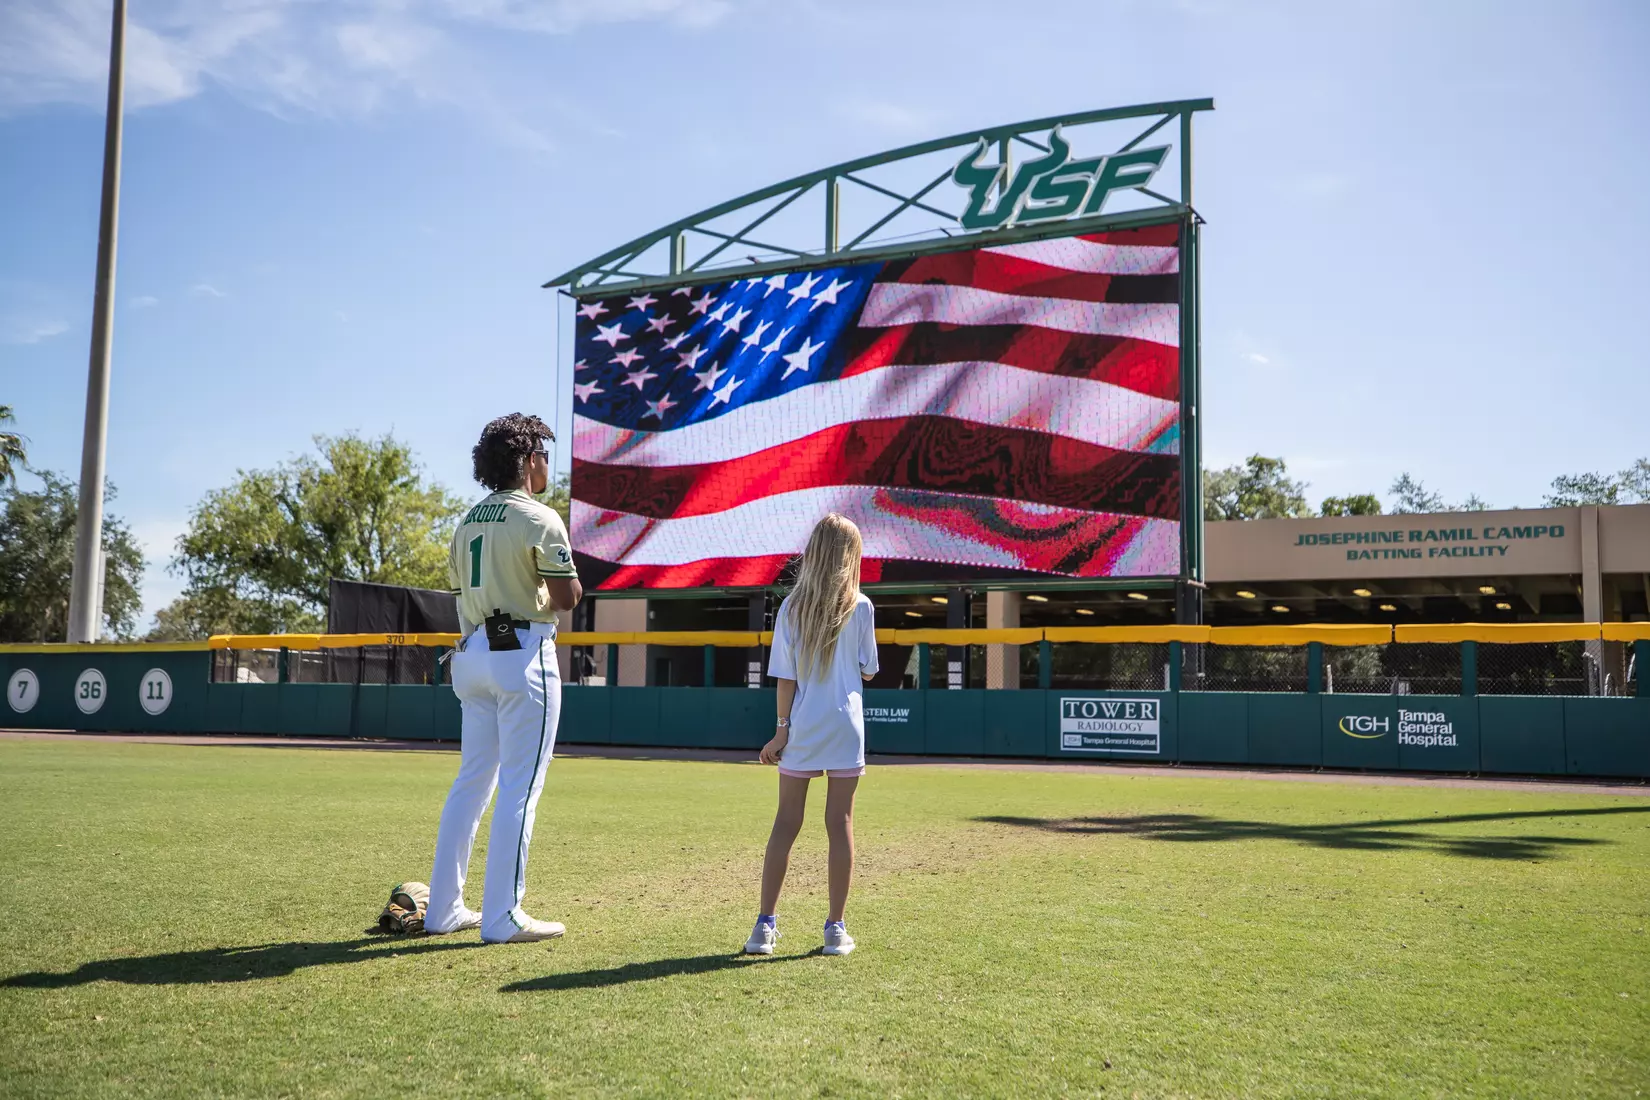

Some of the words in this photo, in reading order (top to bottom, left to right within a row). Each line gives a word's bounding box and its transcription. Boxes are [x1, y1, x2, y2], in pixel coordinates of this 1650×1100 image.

[951, 123, 1173, 233] USF
[1294, 530, 1404, 547] JOSEPHINE
[1408, 528, 1479, 543] RAMIL
[1483, 525, 1565, 540] CAMPO
[469, 533, 484, 589] 1
[1346, 548, 1422, 561] BATTING
[1428, 545, 1510, 558] FACILITY
[386, 634, 405, 645] 370
[17, 681, 29, 699] 7
[79, 681, 101, 699] 36
[146, 681, 164, 700] 11
[863, 707, 888, 717] STEIN
[890, 707, 910, 717] LAW
[1065, 701, 1155, 719] TOWER
[1397, 709, 1446, 724] Tampa
[1077, 721, 1145, 732] RADIOLOGY
[1345, 715, 1389, 732] TGH
[1397, 721, 1453, 734] General
[1083, 736, 1104, 745] Tampa
[1104, 737, 1129, 746] General
[1129, 738, 1156, 747] Hospital
[1398, 732, 1457, 748] Hospital
